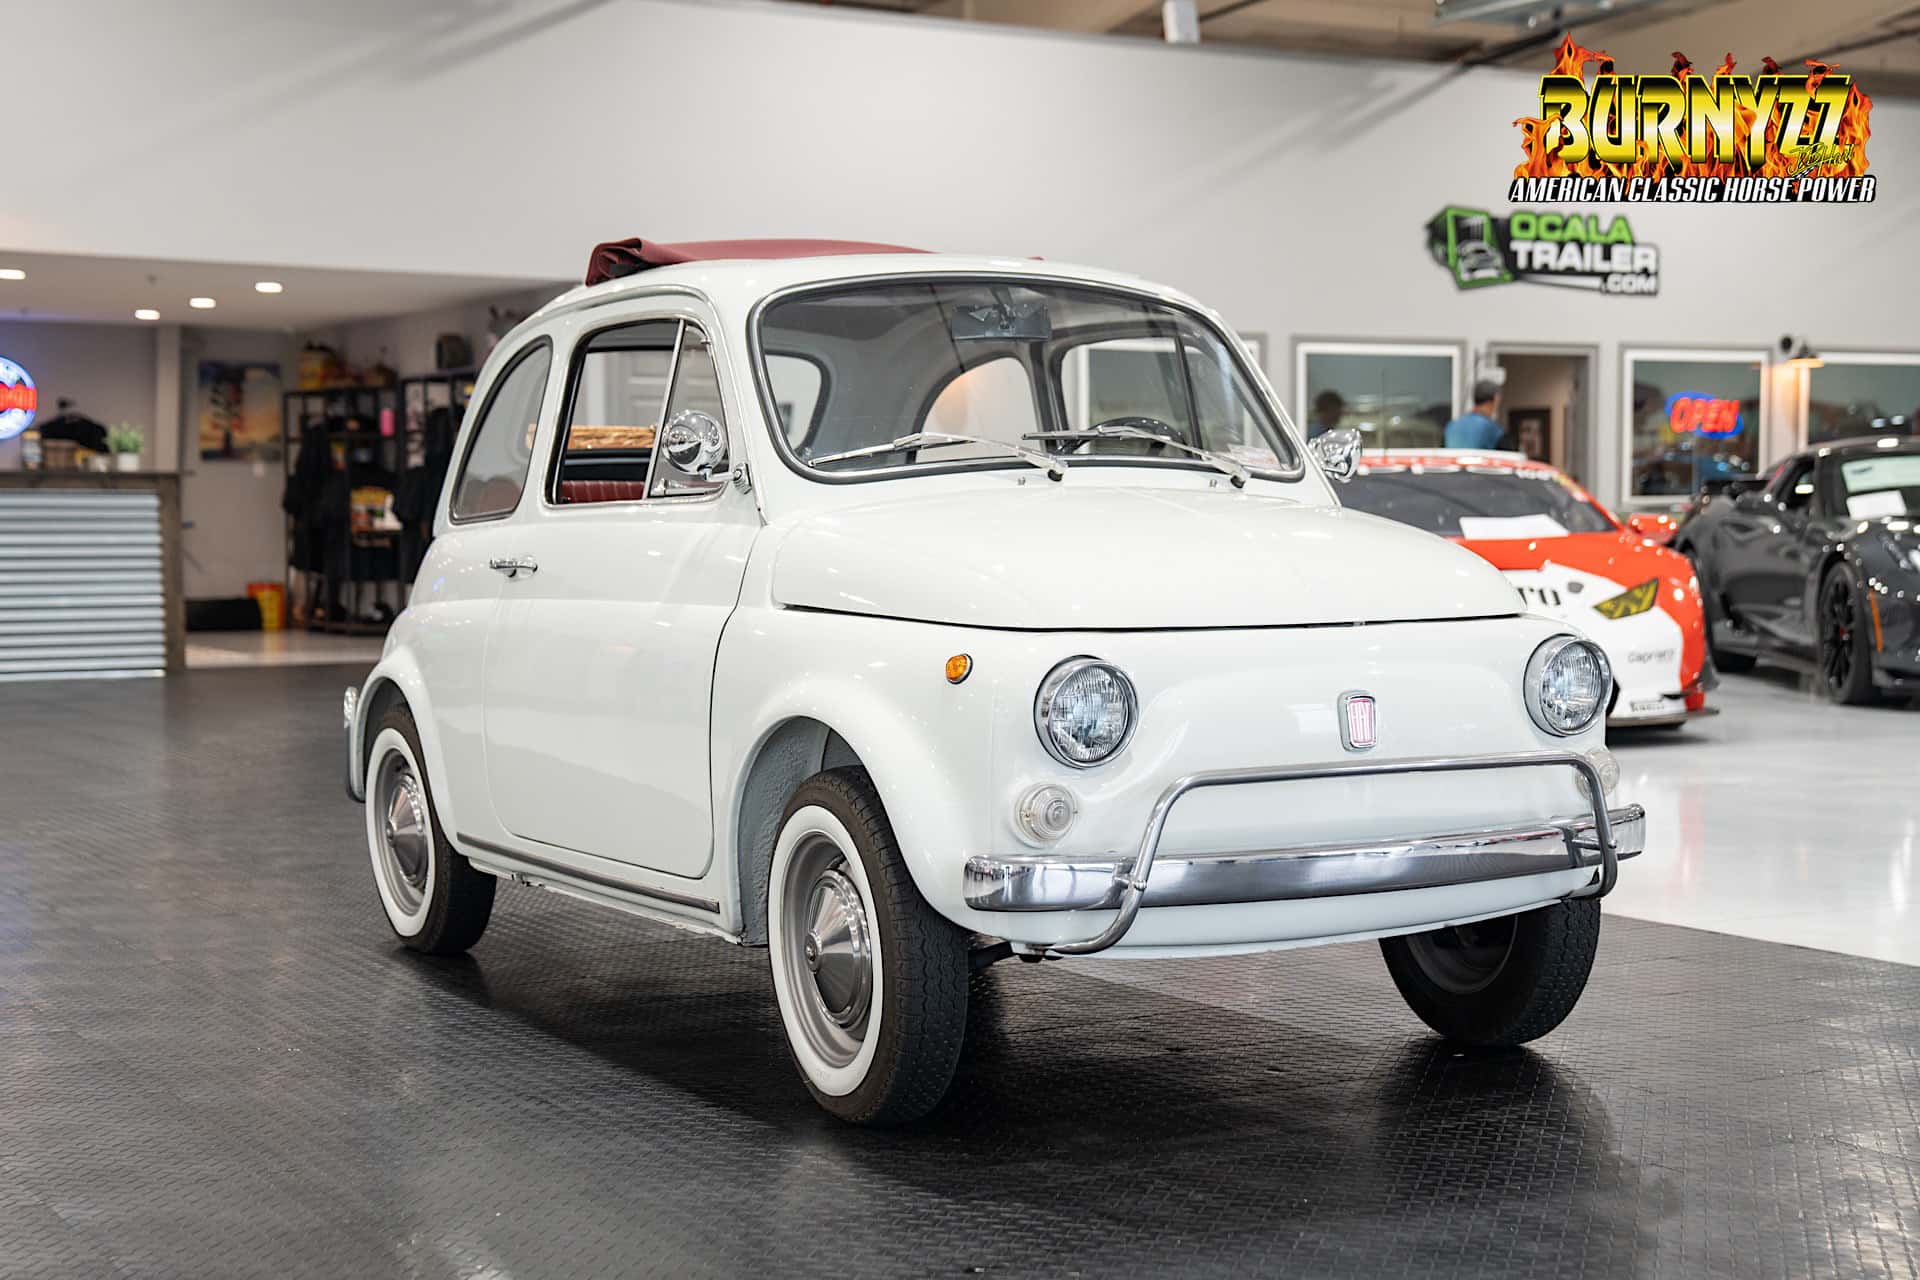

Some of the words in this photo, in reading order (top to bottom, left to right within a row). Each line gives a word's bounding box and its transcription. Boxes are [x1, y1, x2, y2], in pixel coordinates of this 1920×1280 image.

[1510, 212, 1633, 243] OCALA
[1510, 240, 1657, 273] TRAILER
[1670, 397, 1740, 433] OPEN
